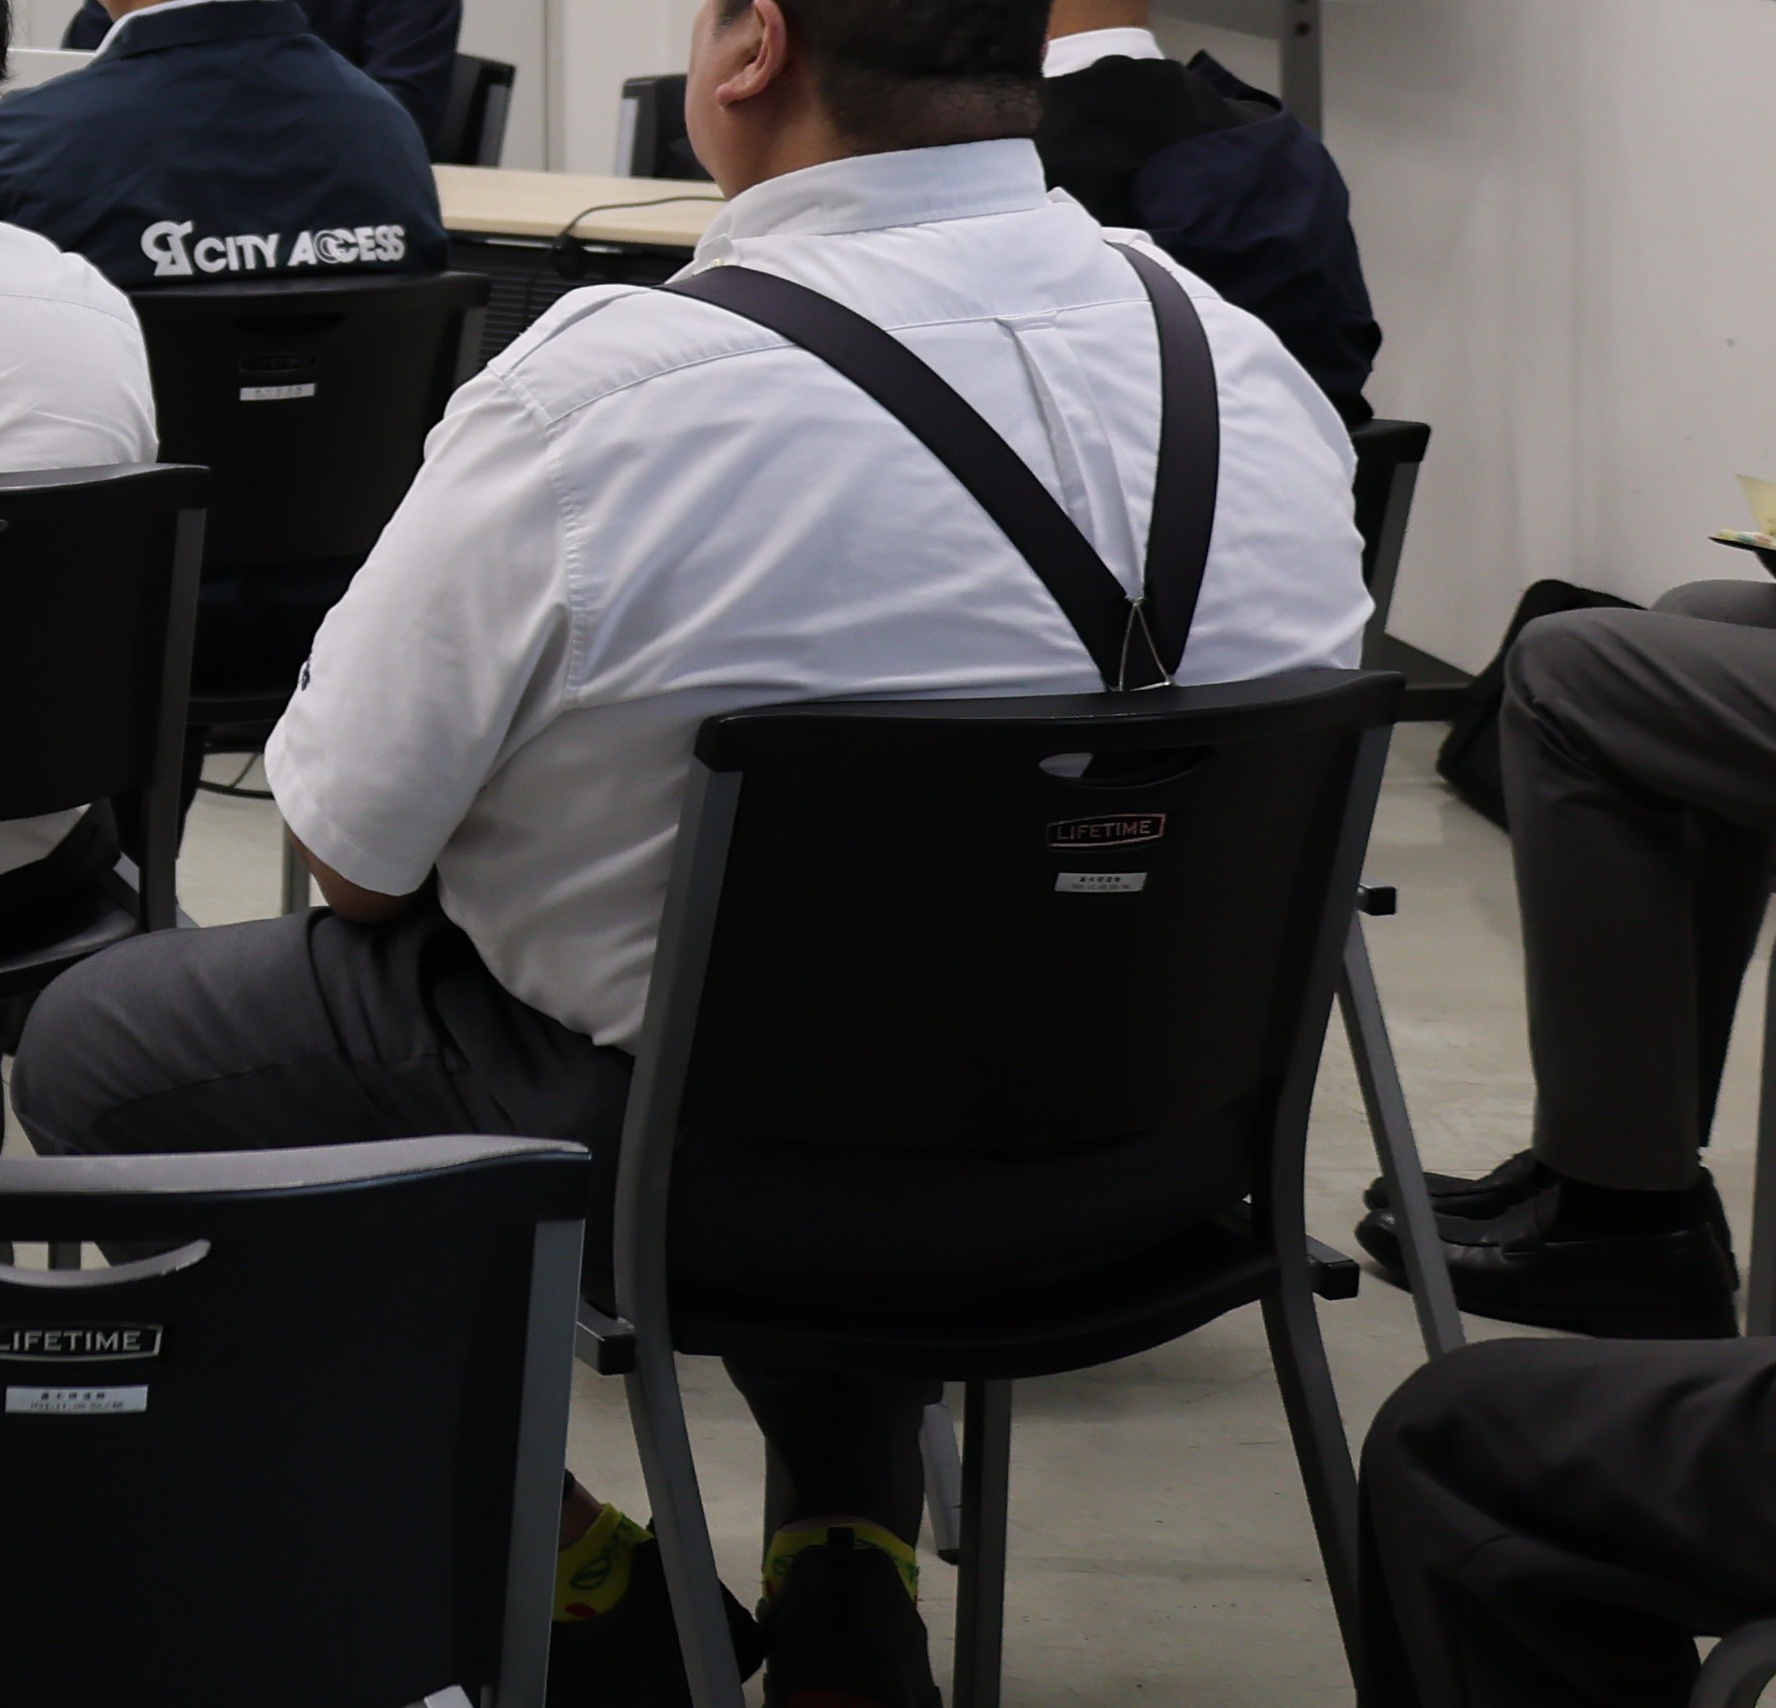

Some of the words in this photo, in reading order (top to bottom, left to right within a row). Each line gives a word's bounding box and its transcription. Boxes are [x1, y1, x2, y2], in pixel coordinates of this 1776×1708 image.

[193, 232, 280, 274] CITY
[287, 224, 406, 267] ACCESS
[1056, 820, 1152, 840] LIFETIME
